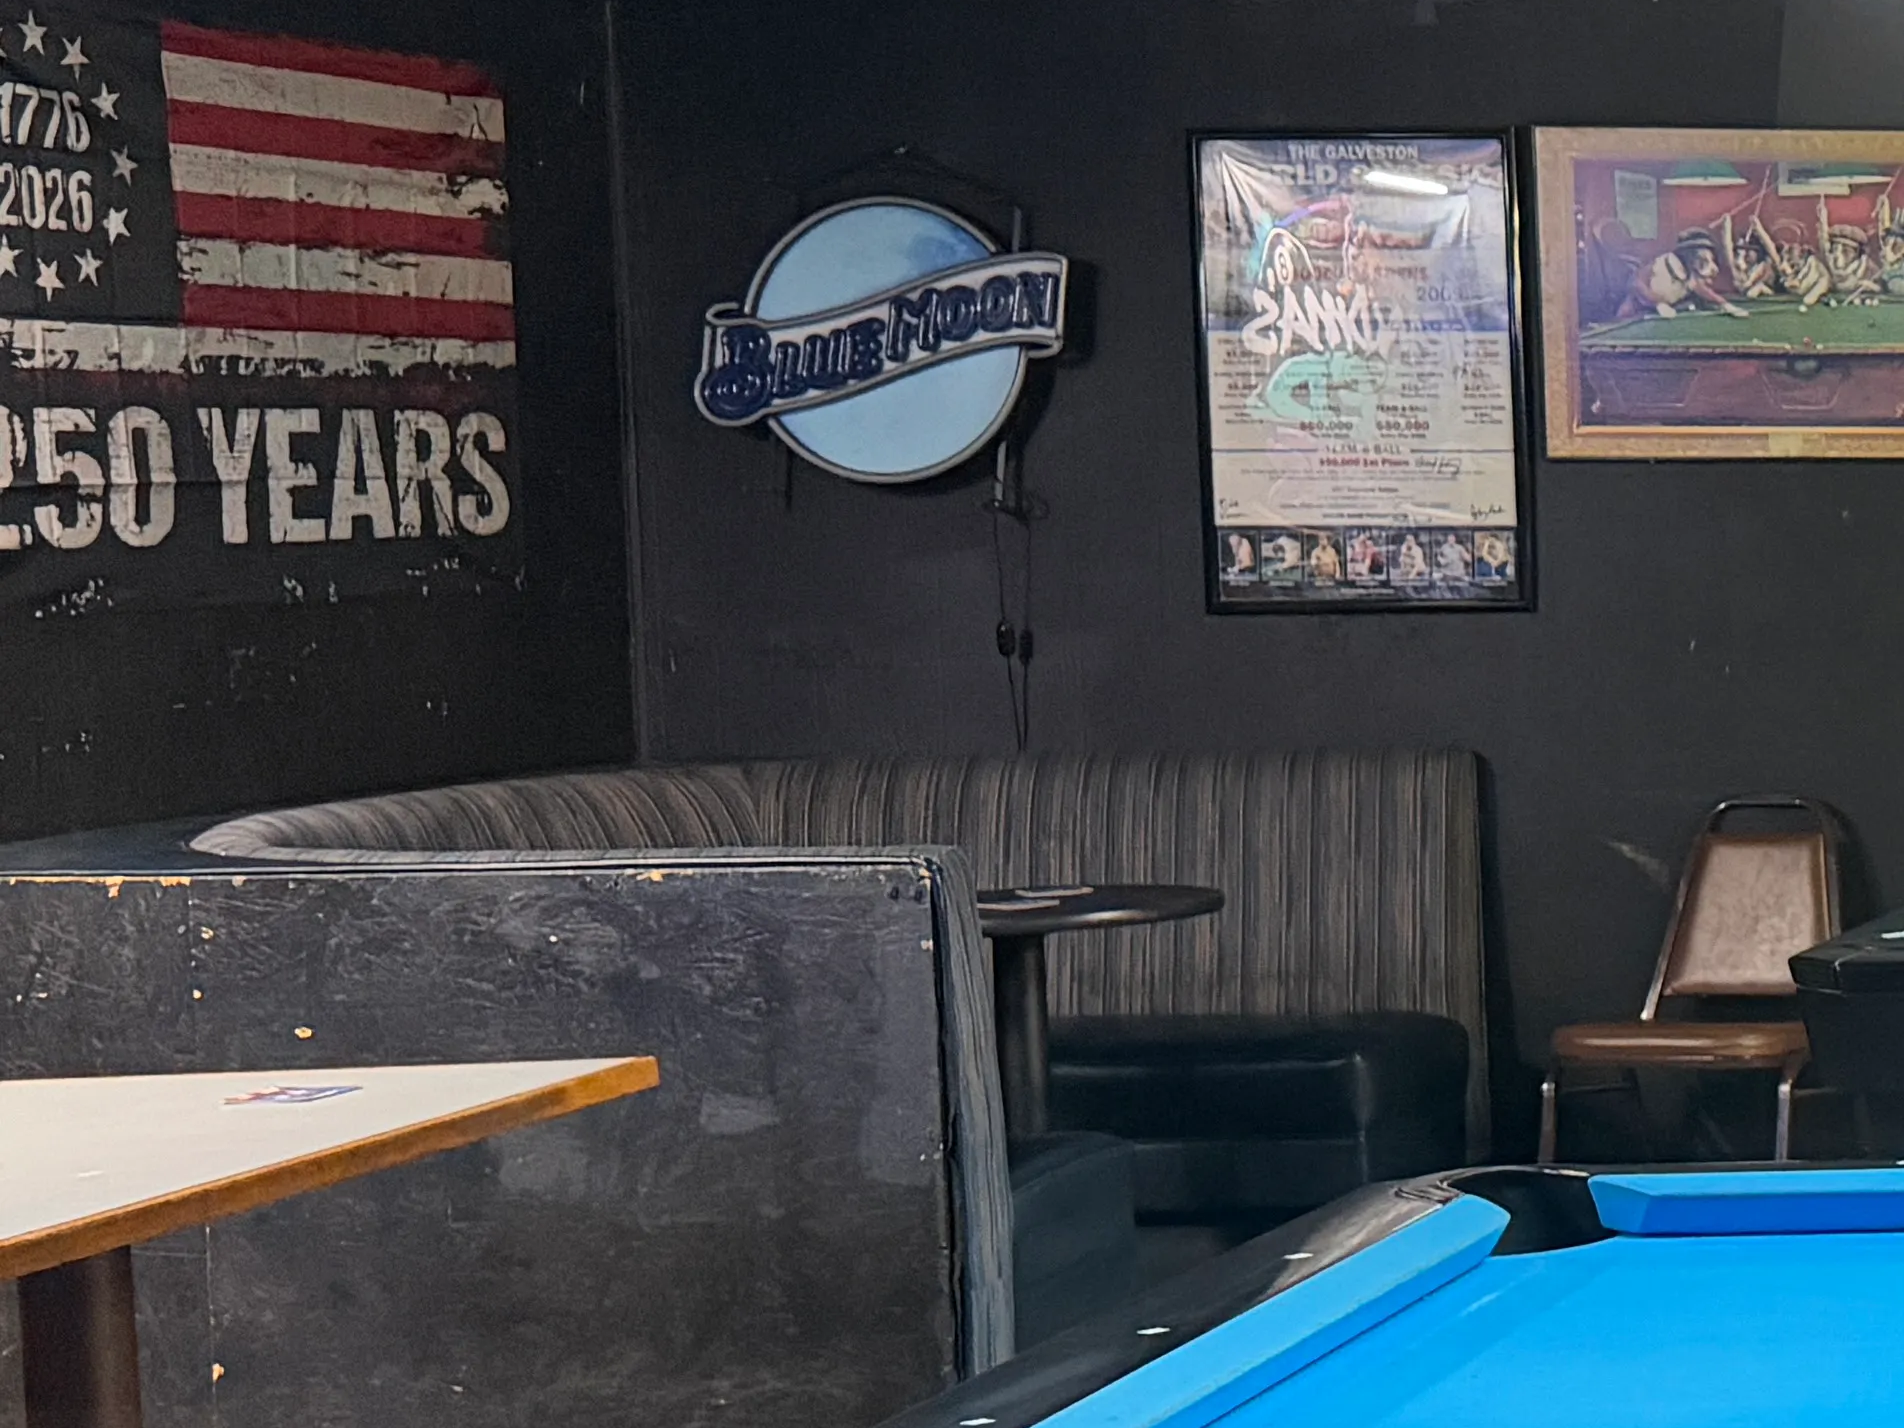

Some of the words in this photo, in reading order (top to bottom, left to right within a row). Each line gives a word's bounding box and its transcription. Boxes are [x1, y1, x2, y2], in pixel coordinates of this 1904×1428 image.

[0, 81, 92, 153] 1776
[1288, 143, 1324, 160] THE
[1326, 143, 1419, 160] GALVESTON
[0, 163, 93, 232] 2026
[197, 408, 512, 544] YEARS
